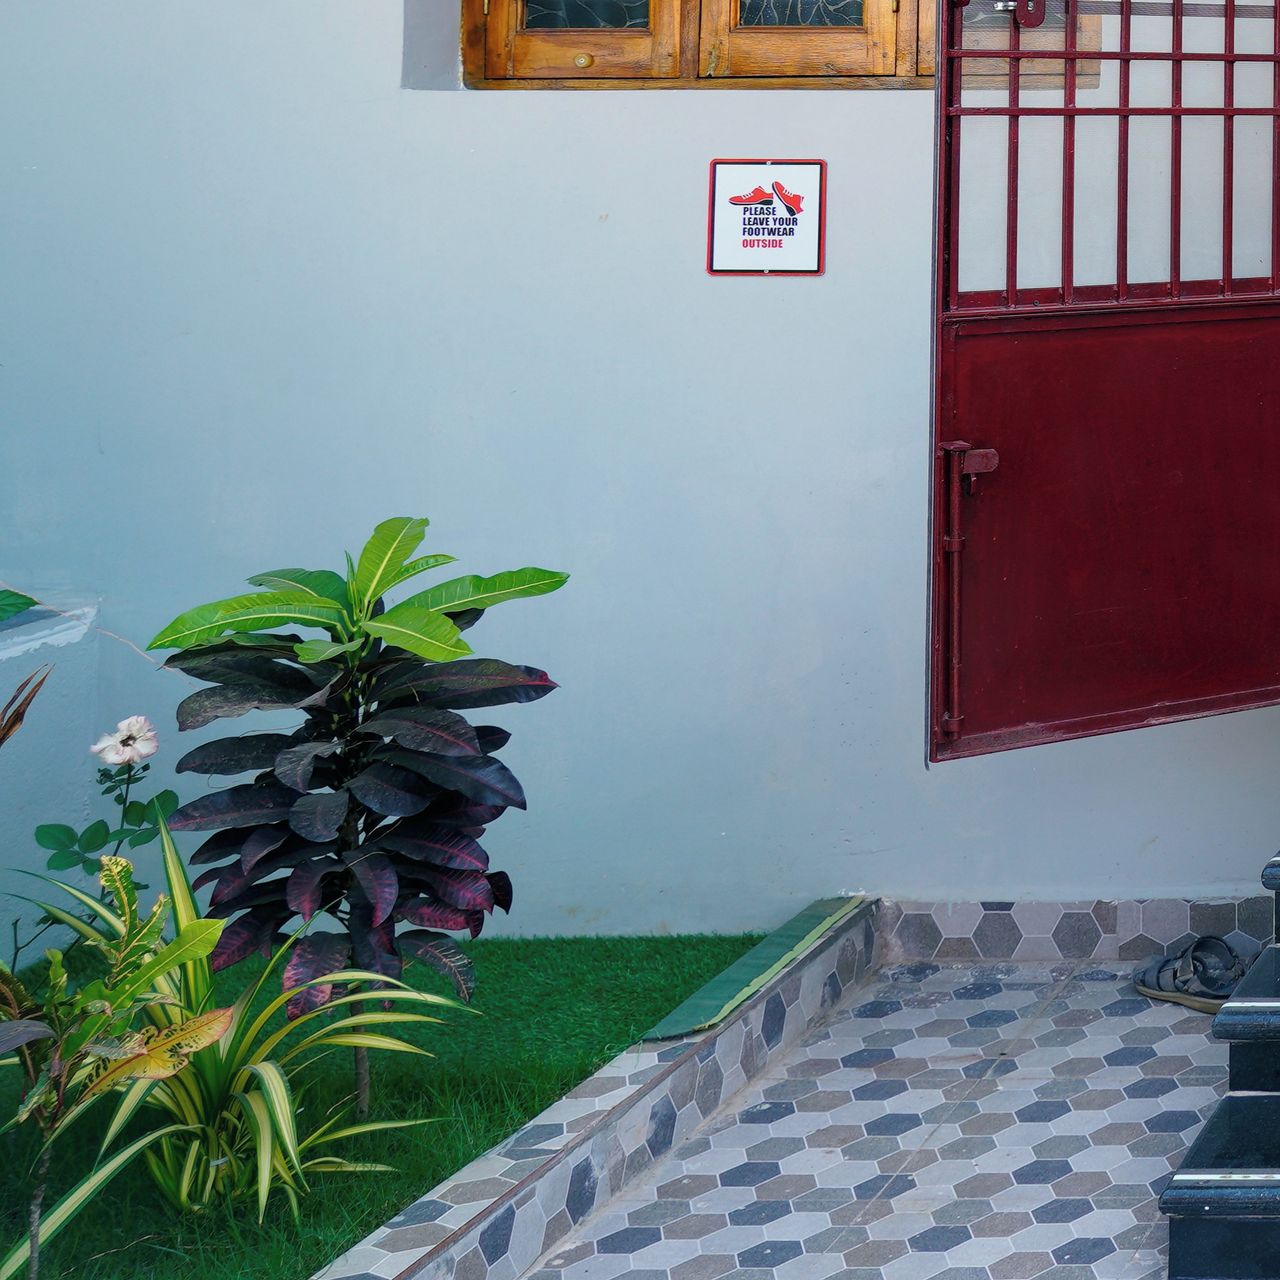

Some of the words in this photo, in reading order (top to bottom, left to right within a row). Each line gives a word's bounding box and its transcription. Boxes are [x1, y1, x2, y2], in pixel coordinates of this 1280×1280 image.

[743, 206, 777, 216] PLEASE
[742, 217, 770, 226] LEAVE
[773, 217, 798, 226] YOUR
[742, 227, 795, 236] FOOTWEAR
[742, 239, 783, 248] OUTSIDE
